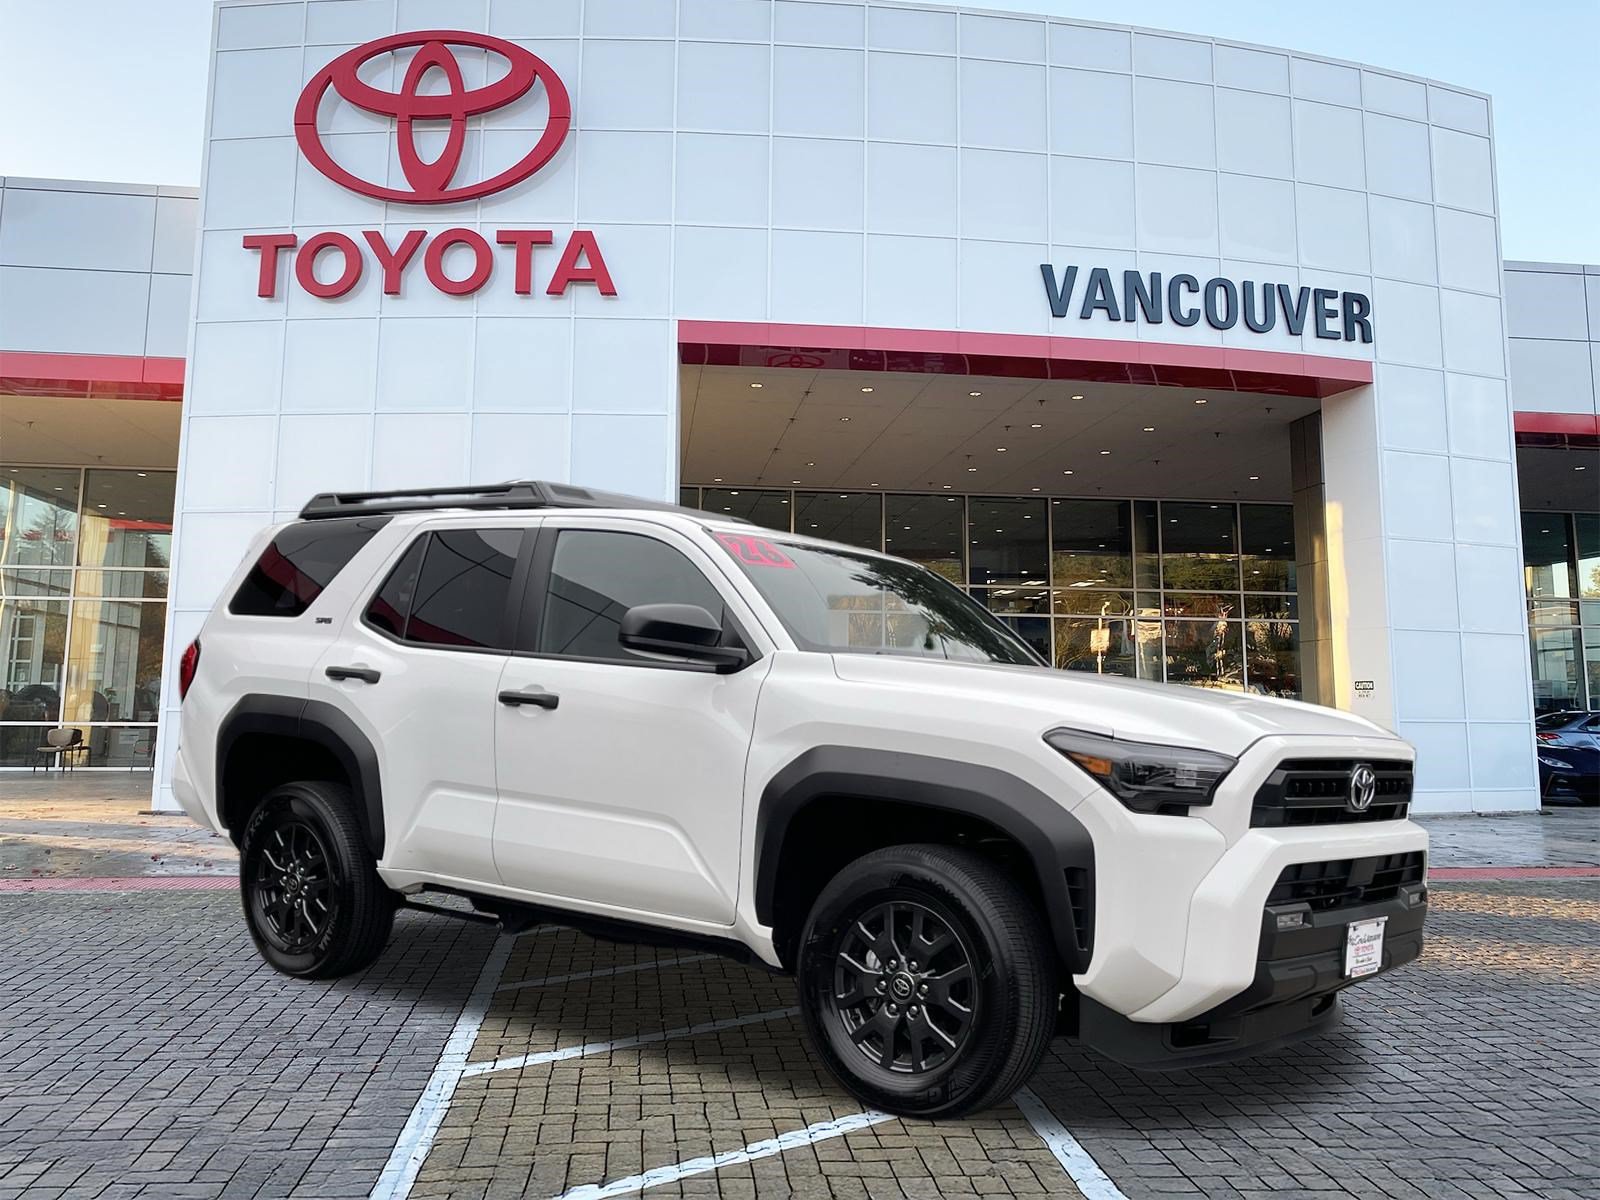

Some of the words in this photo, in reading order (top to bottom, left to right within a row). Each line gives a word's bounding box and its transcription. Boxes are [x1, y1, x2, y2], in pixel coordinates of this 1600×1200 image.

[243, 228, 617, 298] TOYOTA
[1040, 264, 1373, 343] VANCOUVER
[722, 536, 784, 563] 26
